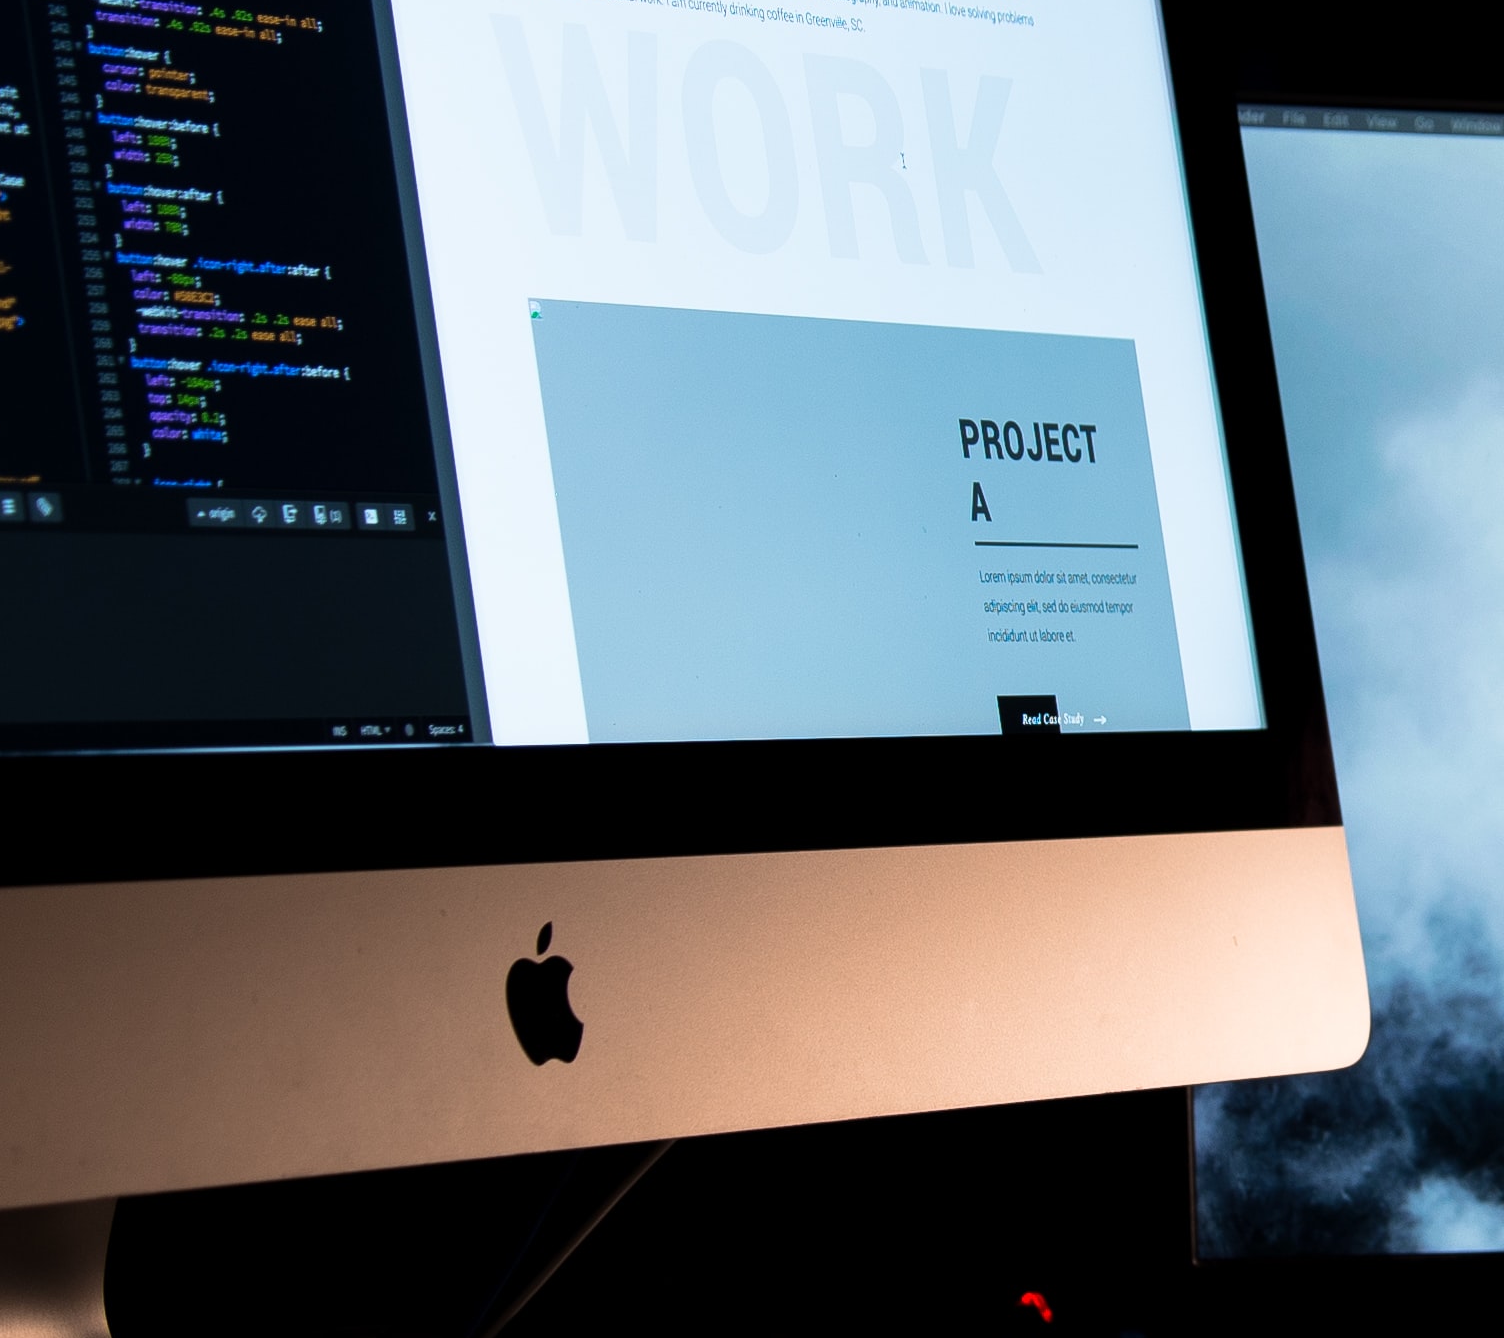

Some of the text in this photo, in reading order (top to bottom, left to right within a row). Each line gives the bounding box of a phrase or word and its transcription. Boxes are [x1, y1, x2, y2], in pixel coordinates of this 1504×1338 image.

[689, 0, 727, 17] currently
[730, 2, 765, 22] drinking
[766, 7, 794, 22] coffee
[796, 14, 804, 24] in
[851, 18, 866, 32] SC.
[949, 2, 966, 17] love
[968, 6, 996, 24] solving
[998, 12, 1034, 26] problems
[488, 12, 1045, 276] WORK
[958, 418, 1097, 463] PROJECT
[971, 481, 992, 522] A
[979, 569, 1137, 585] Lorem ipsum dolor sit amet, consectetur
[984, 599, 1133, 616] adipiscing elit, sed do eiusmod tempor
[988, 628, 1075, 642] incididunt ut labore et.
[1022, 712, 1085, 727] Read Case Study
